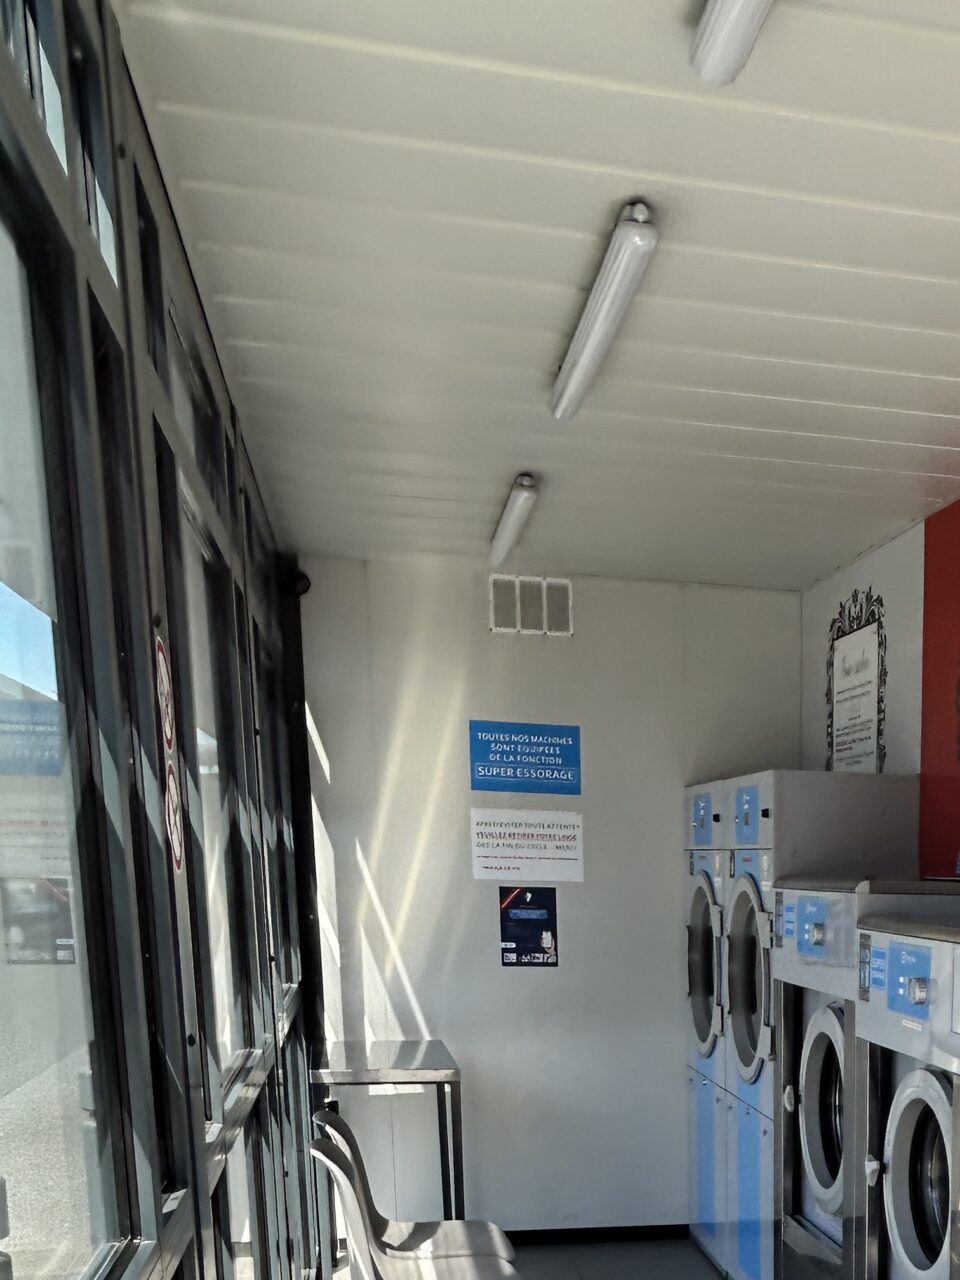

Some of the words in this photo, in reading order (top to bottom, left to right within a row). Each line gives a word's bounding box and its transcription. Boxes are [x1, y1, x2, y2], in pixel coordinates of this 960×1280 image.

[478, 732, 510, 741] TOUTES
[511, 734, 529, 742] NOS
[531, 735, 573, 745] MACHINES
[490, 742, 515, 751] SONT
[489, 753, 501, 761] DE
[503, 754, 515, 762] LA
[517, 754, 562, 764] FONCTION
[478, 766, 514, 777] SUPER
[516, 768, 574, 780] ESSORAGE
